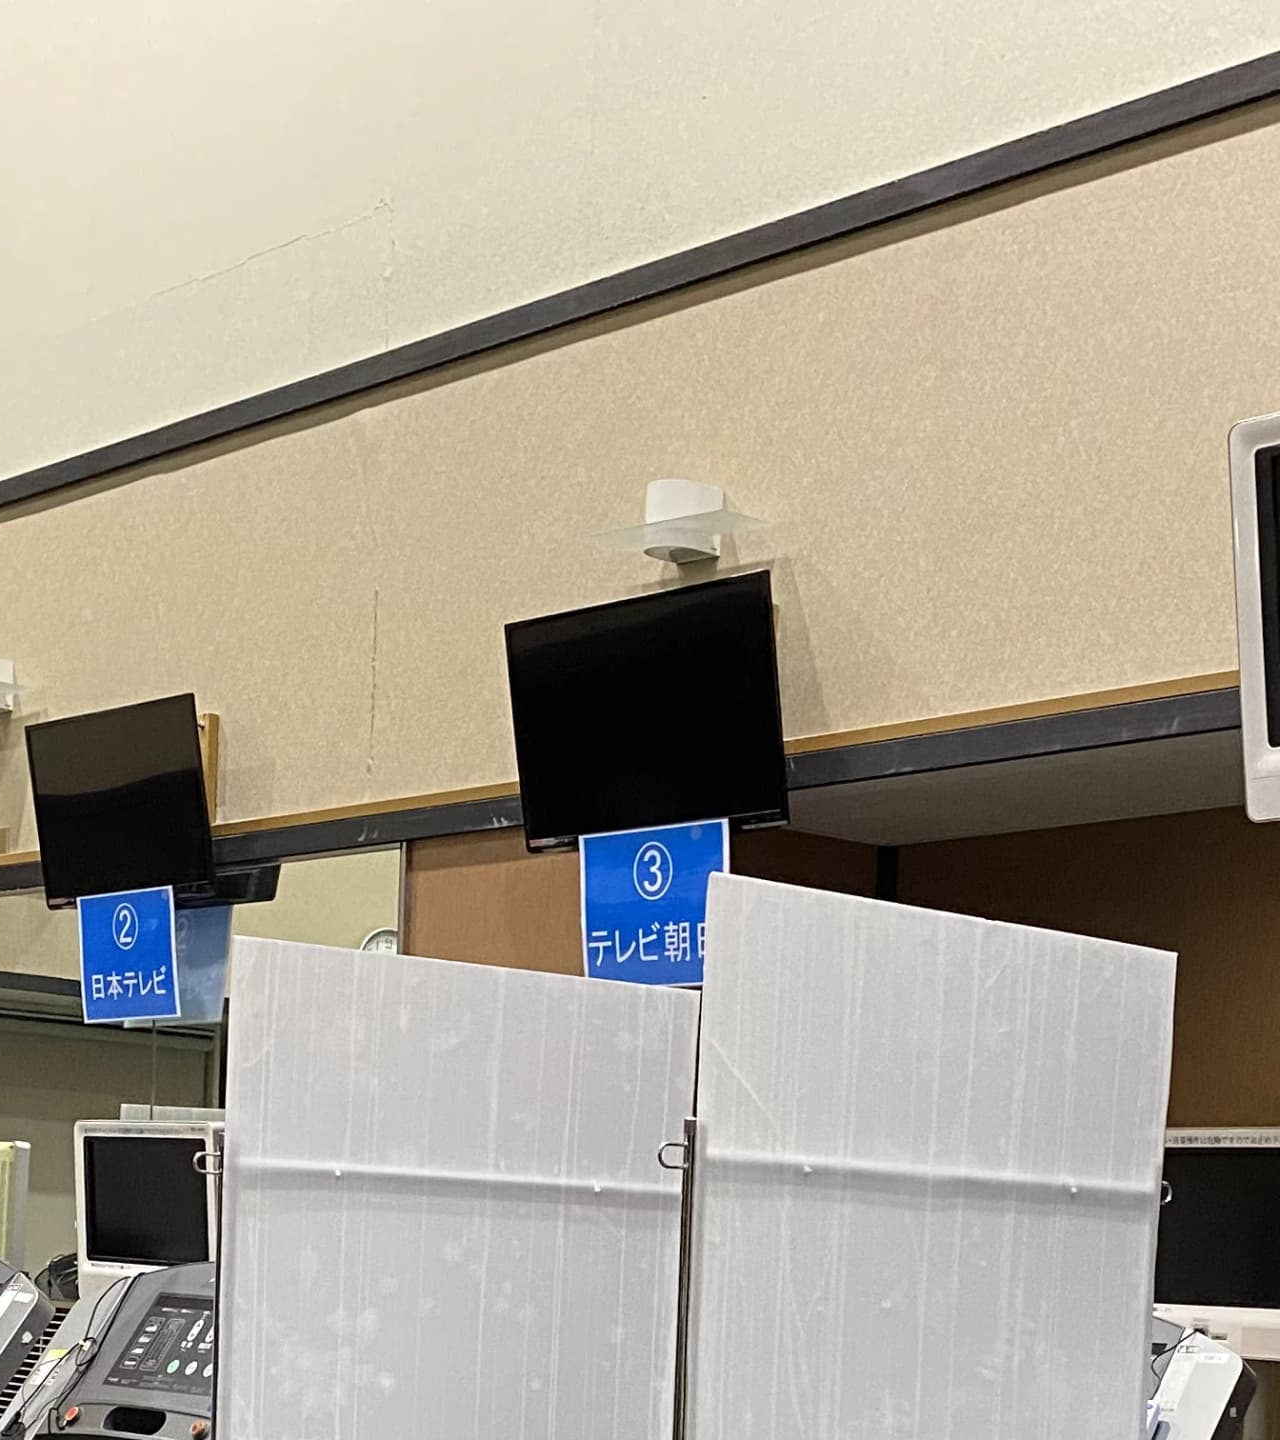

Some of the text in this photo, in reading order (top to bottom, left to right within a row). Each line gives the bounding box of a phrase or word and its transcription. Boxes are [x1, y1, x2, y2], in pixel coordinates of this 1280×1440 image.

[91, 964, 167, 1001] 日本テレビ
